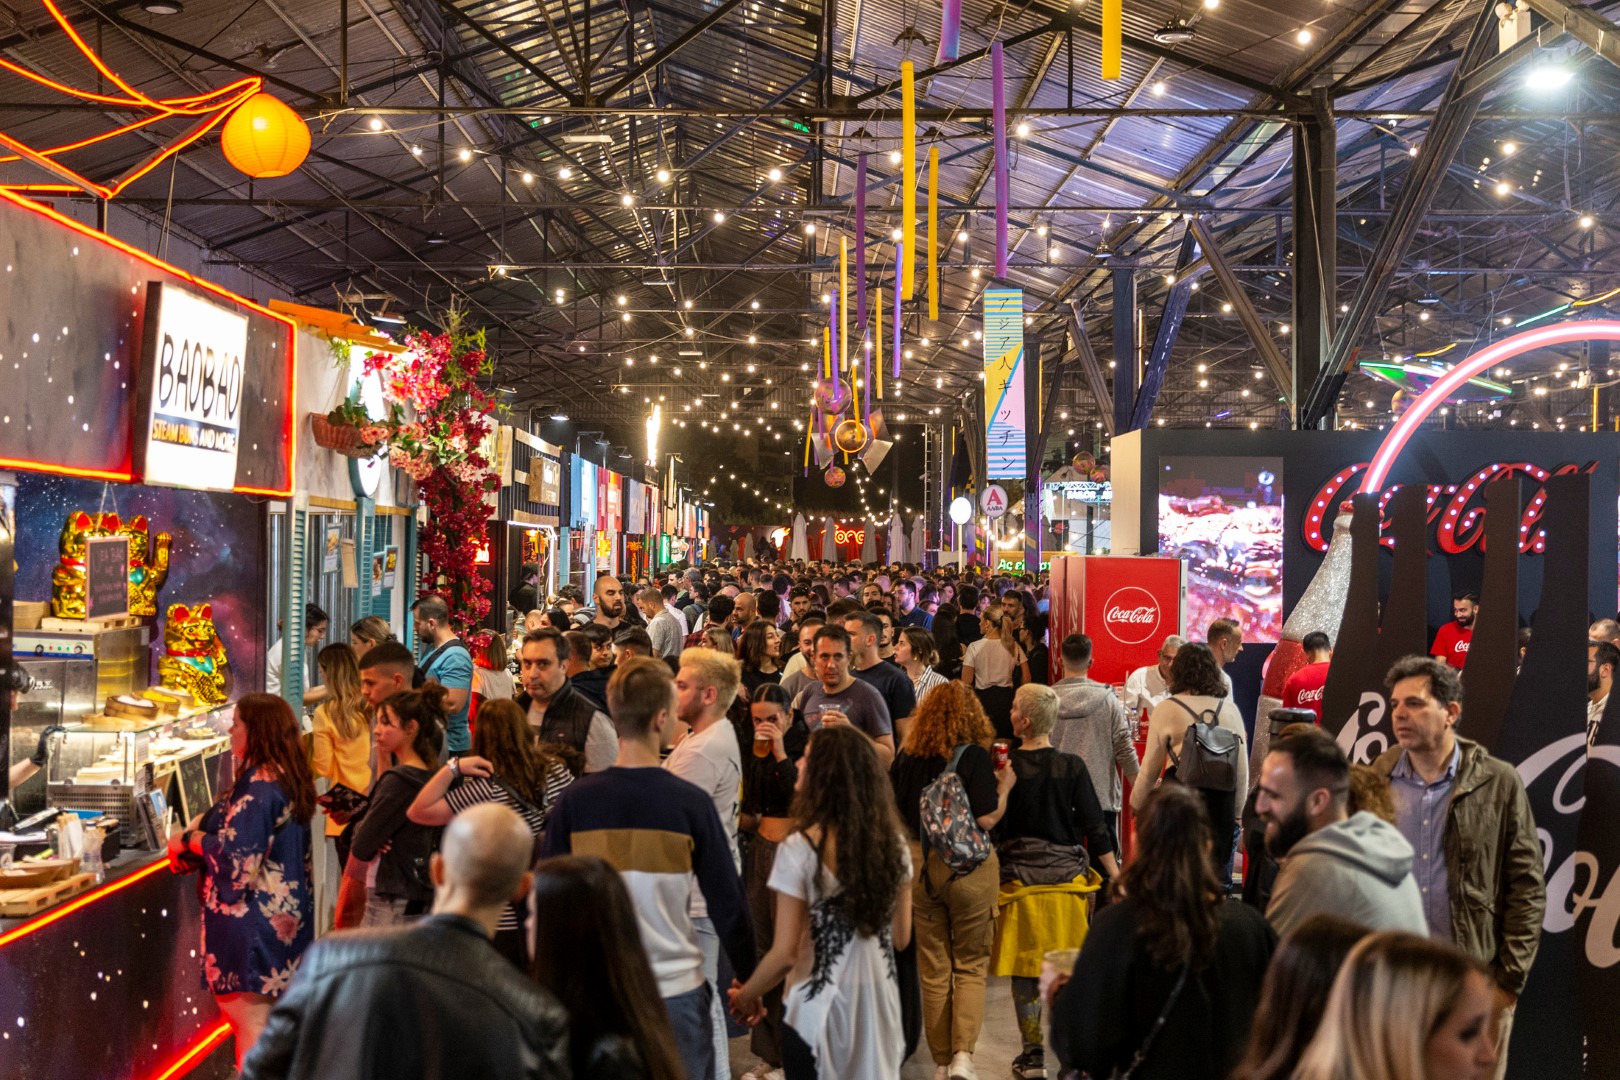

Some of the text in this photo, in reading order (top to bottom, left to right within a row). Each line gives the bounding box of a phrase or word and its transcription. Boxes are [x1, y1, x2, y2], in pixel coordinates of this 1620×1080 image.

[159, 331, 241, 420] BAOBAO
[152, 418, 179, 441] STEAM
[1107, 606, 1158, 623] Coca-Cola
